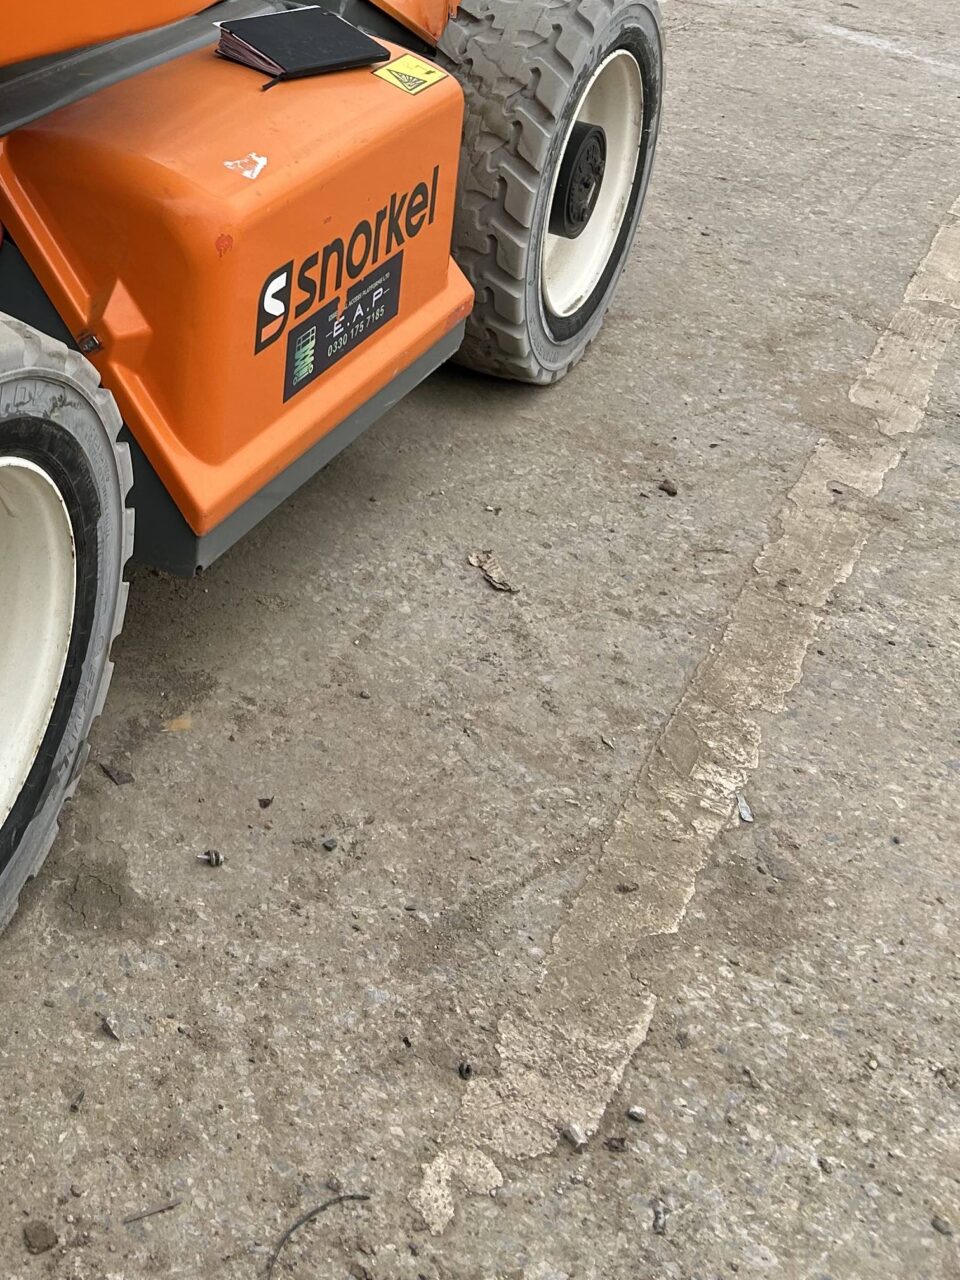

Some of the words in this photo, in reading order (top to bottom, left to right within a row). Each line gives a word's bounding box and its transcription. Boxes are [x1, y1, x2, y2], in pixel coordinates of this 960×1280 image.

[327, 334, 348, 357] 0330
[350, 322, 365, 345] 175
[366, 305, 385, 328] 7185
